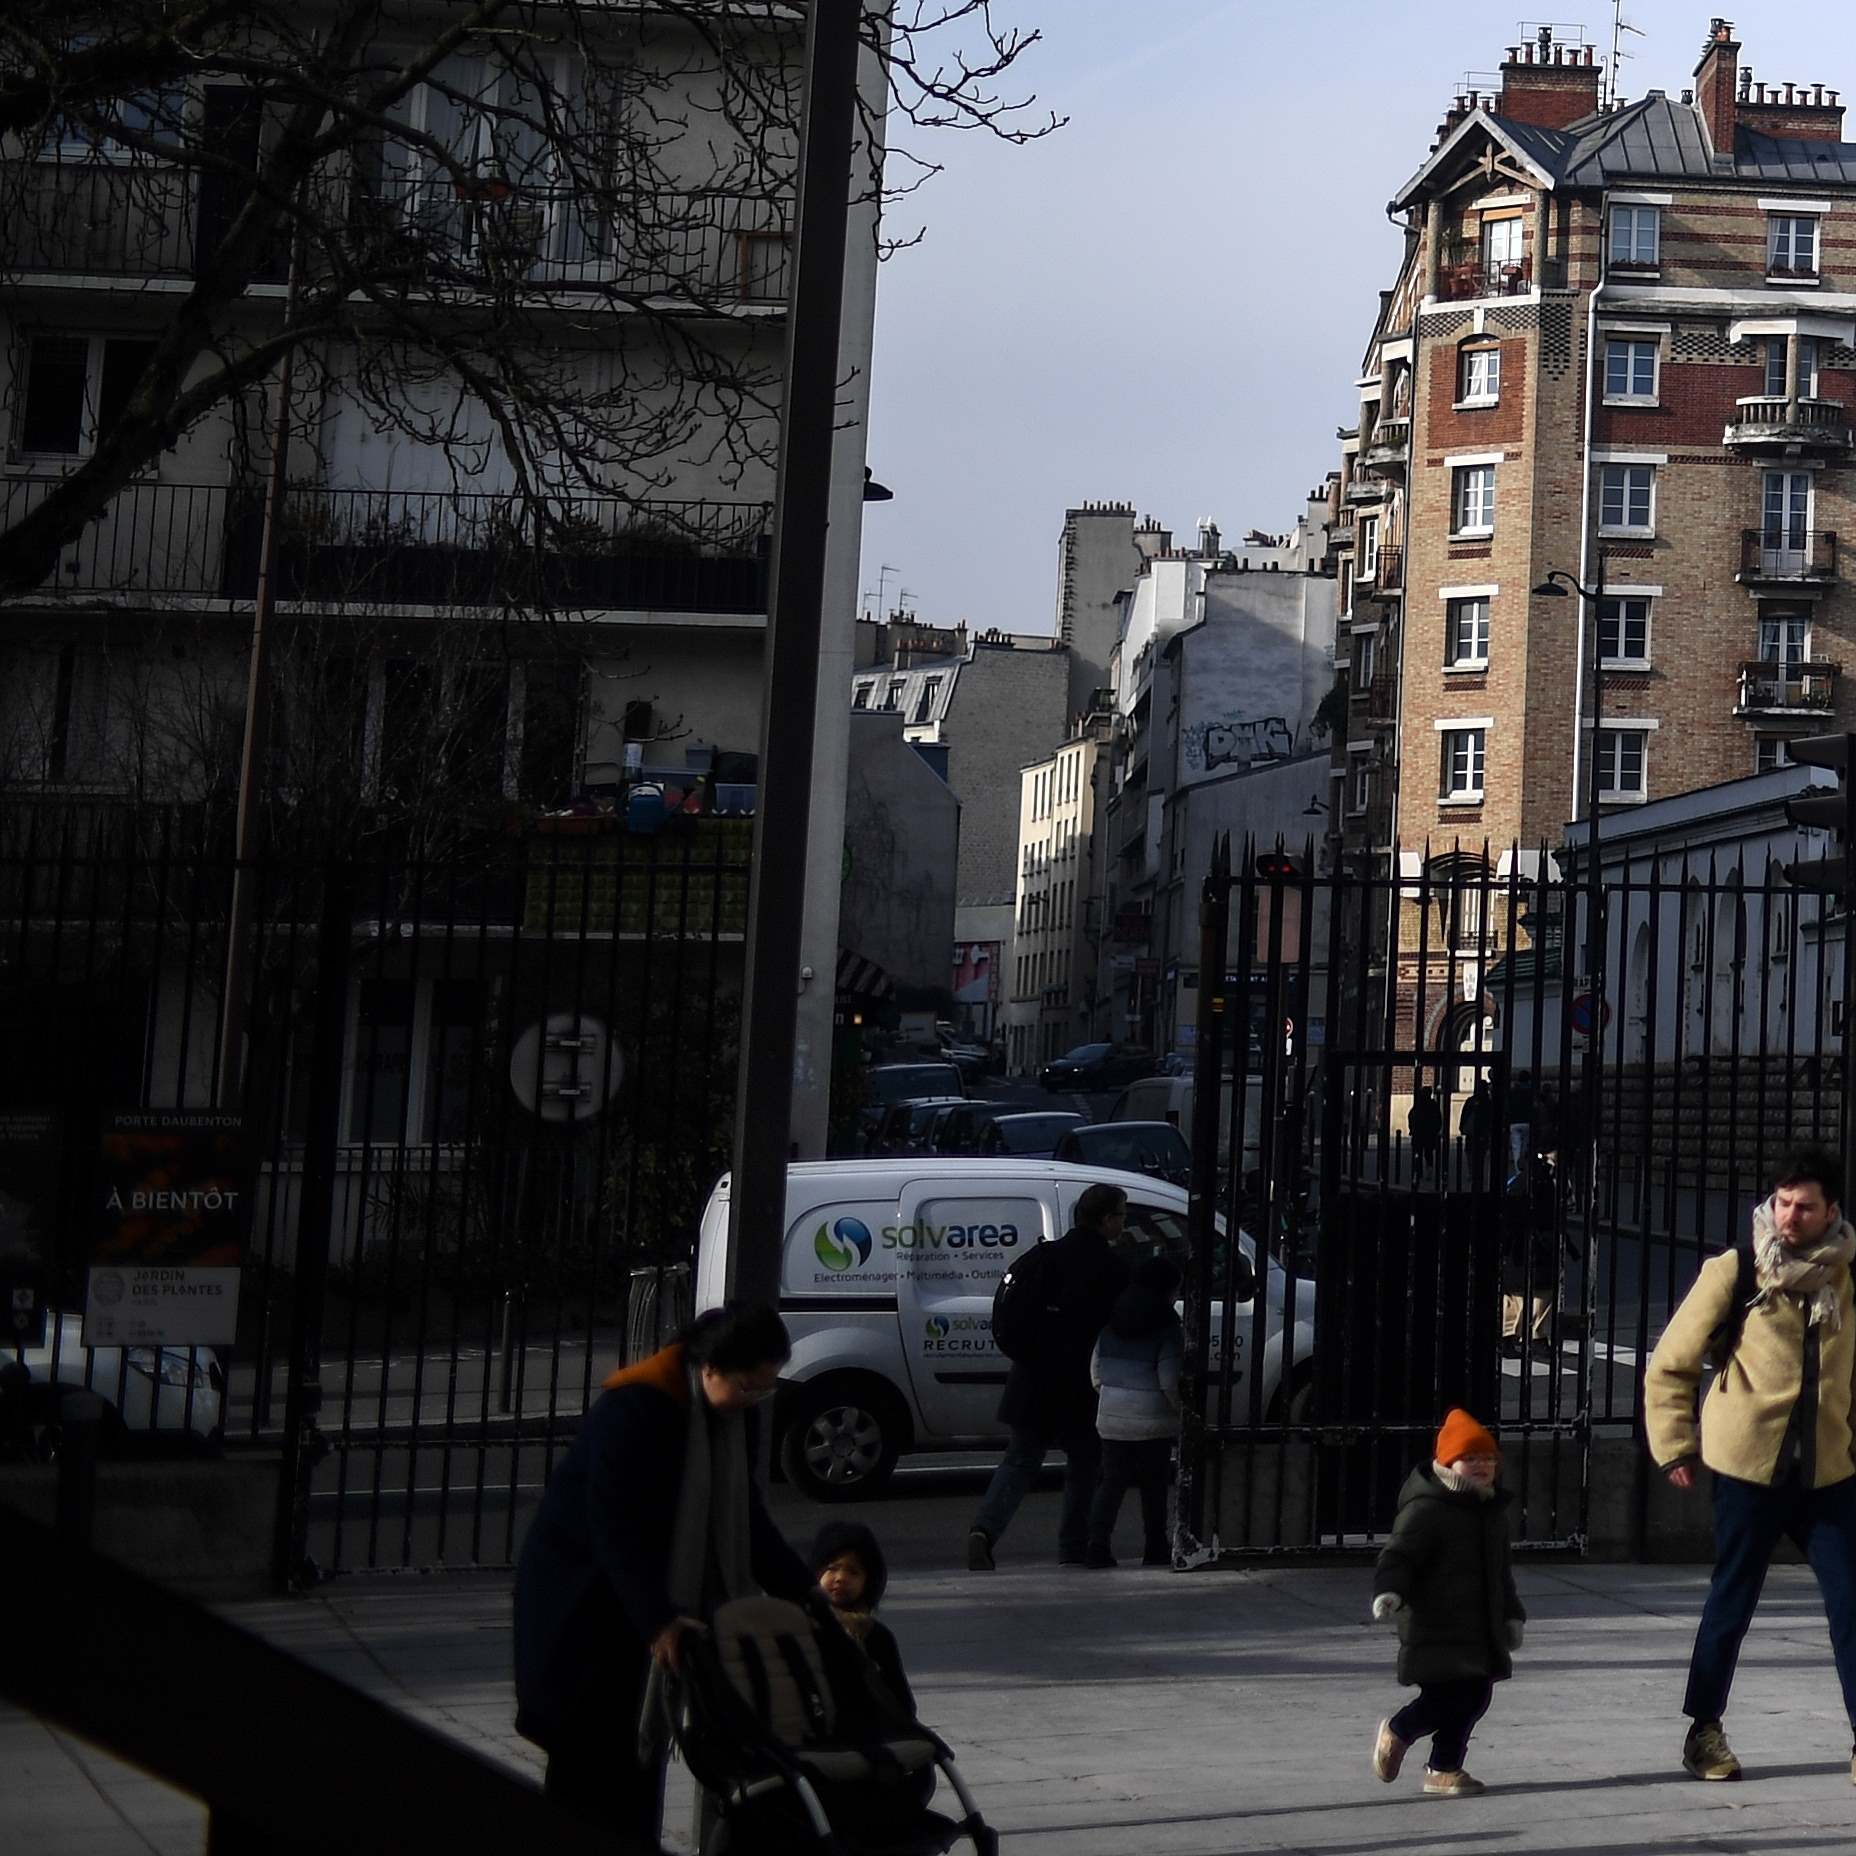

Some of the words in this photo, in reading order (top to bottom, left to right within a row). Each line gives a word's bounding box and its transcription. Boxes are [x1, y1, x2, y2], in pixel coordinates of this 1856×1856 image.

[114, 1115, 158, 1127] PORTE
[162, 1115, 243, 1127] DAUBENTON
[105, 1183, 123, 1209] À
[132, 1185, 240, 1209] BIENTÔT
[881, 1218, 1018, 1250] solvarea
[962, 1250, 1004, 1261] Services
[133, 1270, 185, 1281] JARDIN
[132, 1285, 158, 1296] DES
[162, 1285, 223, 1296] PLANTES
